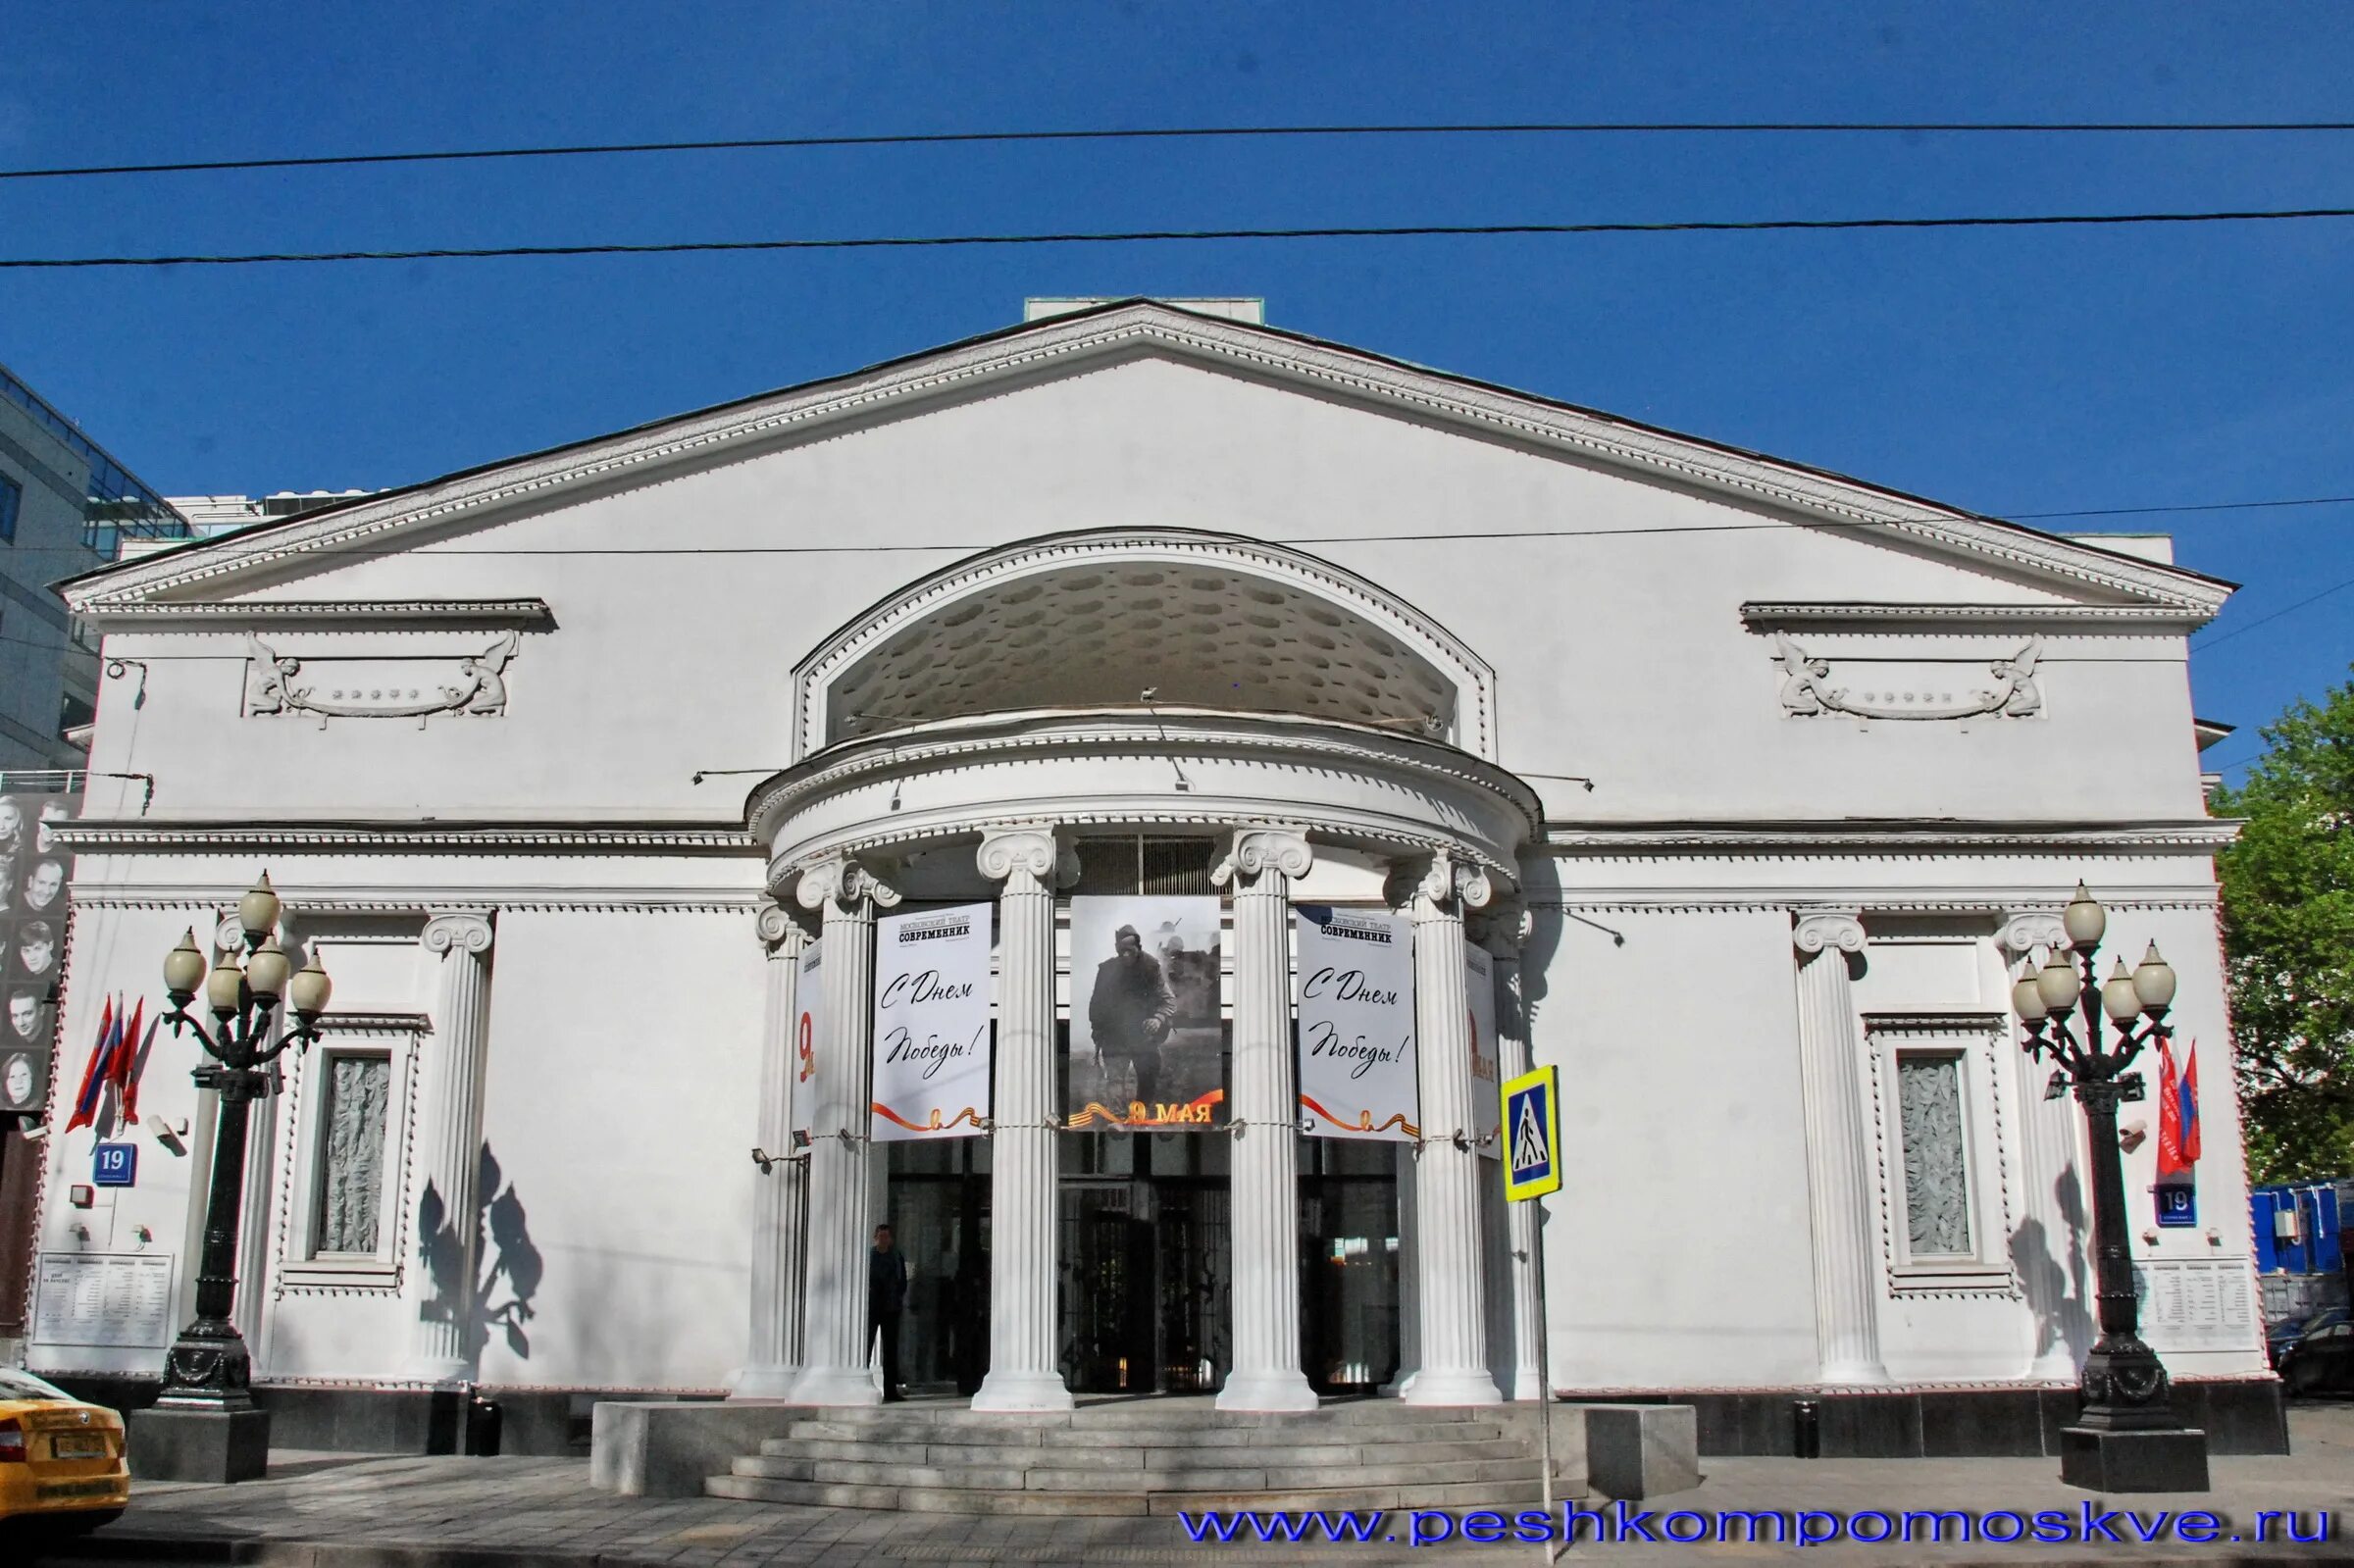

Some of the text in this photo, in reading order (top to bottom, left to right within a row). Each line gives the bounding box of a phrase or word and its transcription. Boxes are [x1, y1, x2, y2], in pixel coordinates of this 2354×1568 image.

[898, 925, 970, 942] СОВРЕМЕННИК
[1320, 925, 1392, 943] СОВРЕМЕННИК
[1369, 922, 1392, 931] ТЕАТР
[881, 970, 973, 1009] С Днем
[1304, 967, 1398, 1005] С Днем
[884, 1025, 984, 1080] Победы!
[1308, 1020, 1409, 1080] Победы!
[1129, 1099, 1212, 1123] 9 МАЯ
[102, 1150, 125, 1170] 19
[2165, 1190, 2188, 1211] 19
